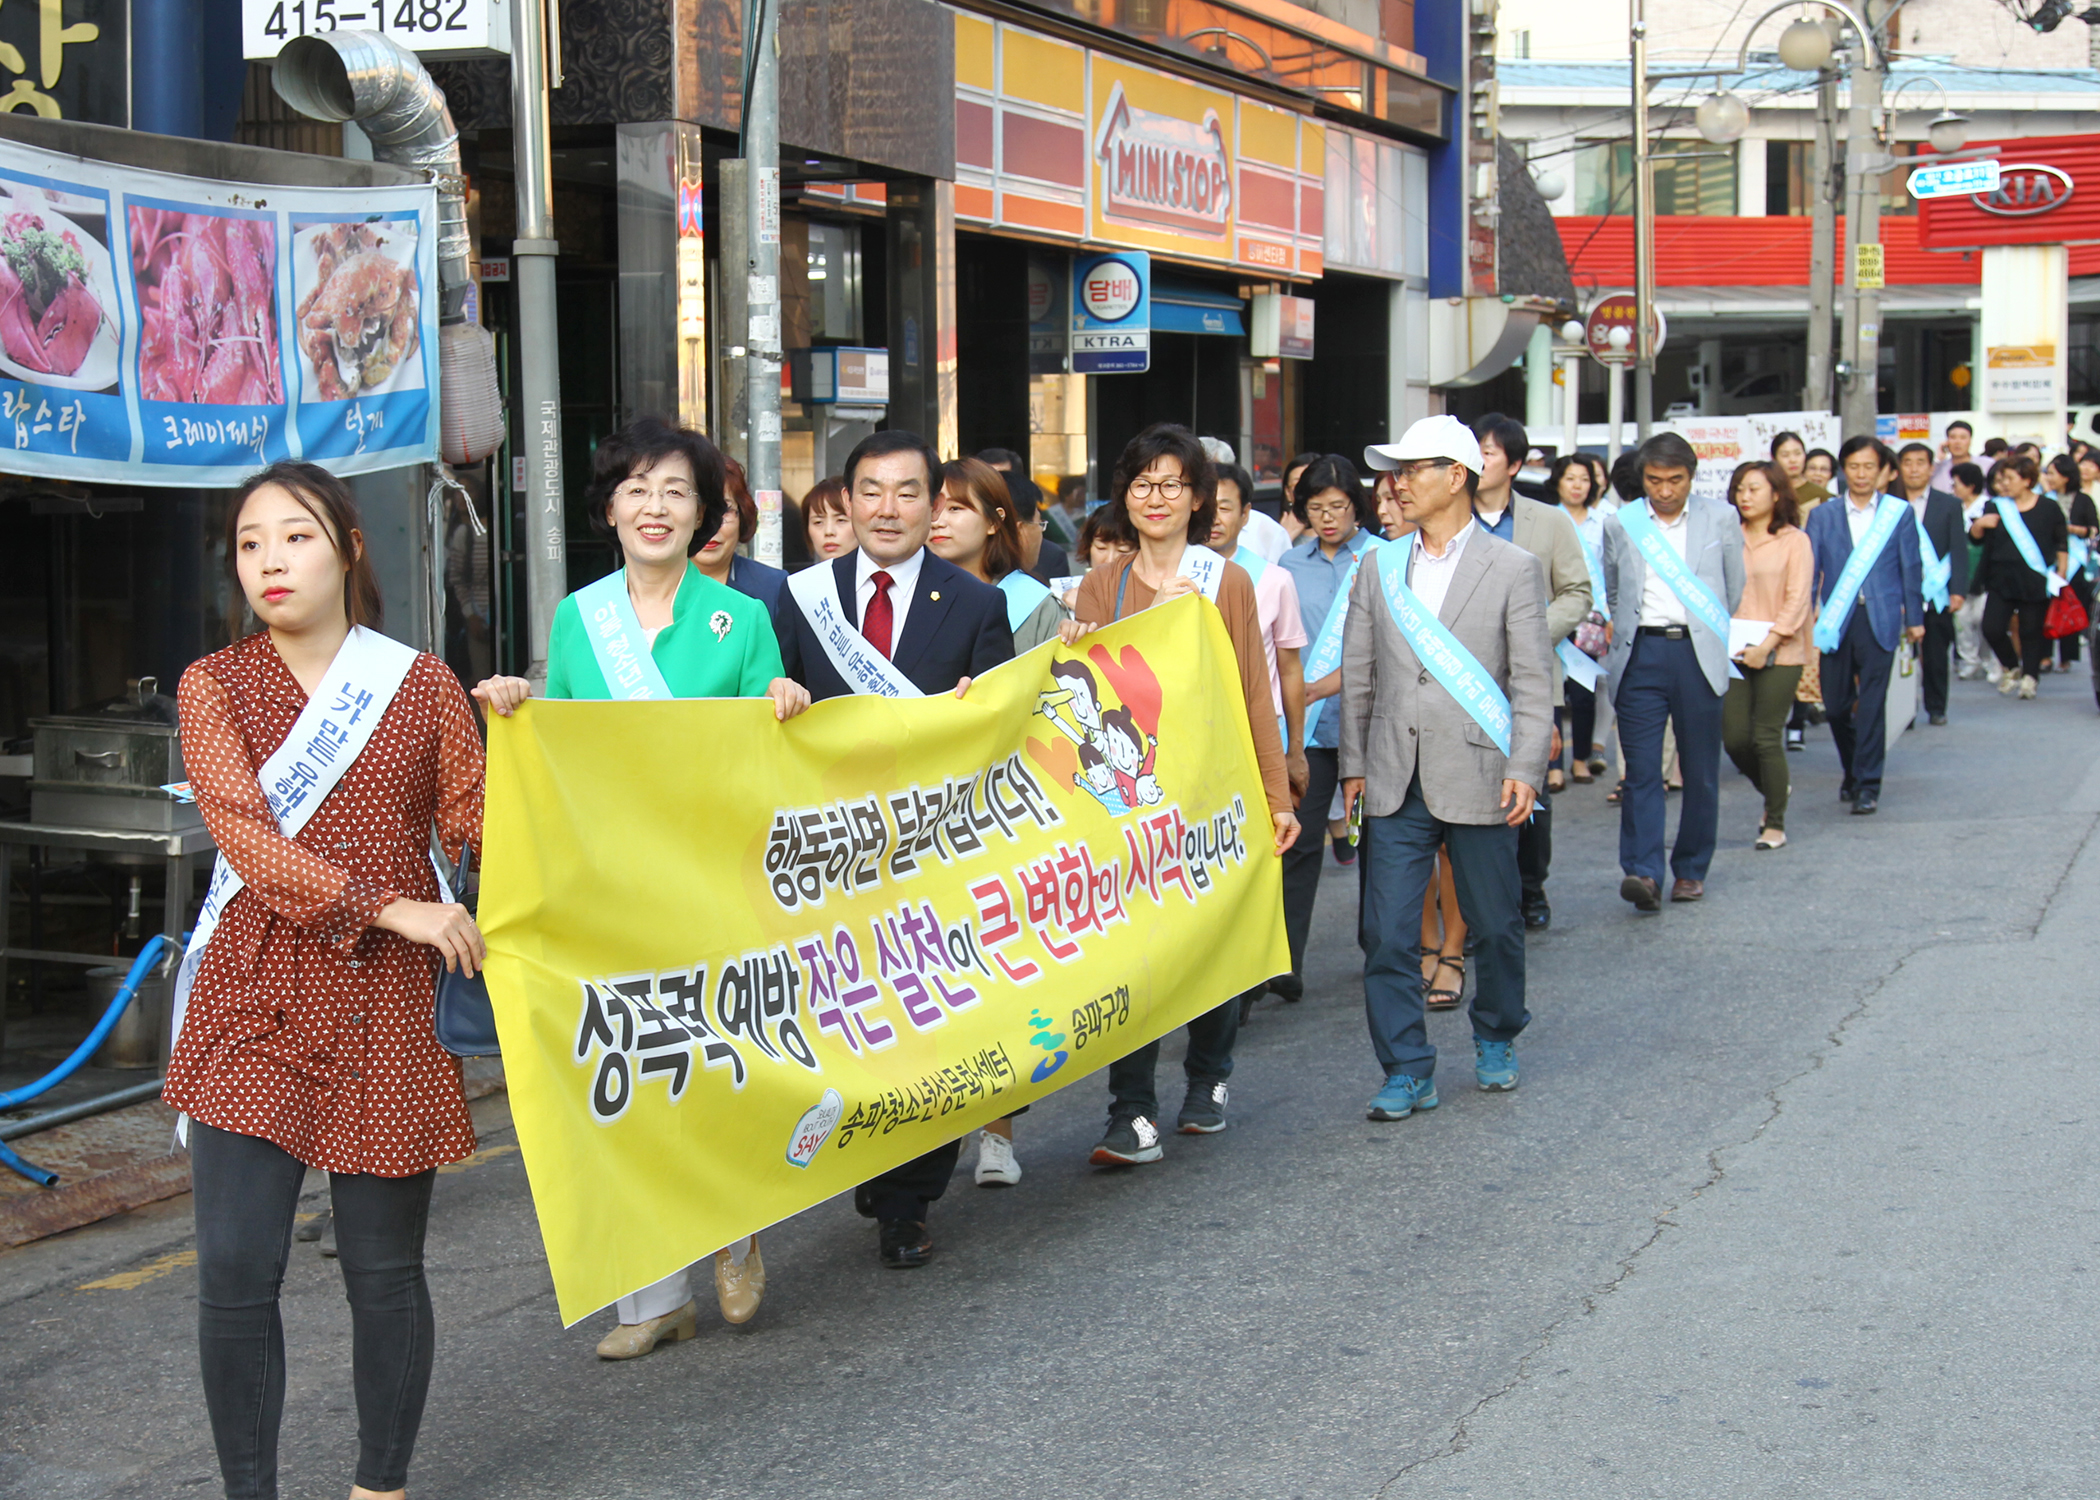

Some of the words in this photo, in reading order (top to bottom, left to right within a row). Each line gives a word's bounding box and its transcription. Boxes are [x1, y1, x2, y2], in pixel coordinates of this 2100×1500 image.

[1112, 138, 1225, 215] MINISTOP
[1988, 174, 2056, 204] KIA
[1089, 279, 1132, 302] 담배
[1084, 336, 1134, 348] KTRA
[345, 401, 384, 455] 털게
[540, 400, 560, 517] 국제관광도시
[546, 525, 562, 564] 송파
[1190, 560, 1213, 584] 내가
[594, 600, 623, 639] 아동
[813, 596, 834, 631] 내가
[829, 623, 852, 658] 만든
[605, 633, 644, 689] 청소년
[1320, 635, 1341, 661] 우리
[1393, 591, 1422, 633] 청소년
[1415, 627, 1464, 677] 유해환경
[1456, 671, 1486, 701] 우리
[1478, 694, 1511, 734] 모두의
[329, 681, 374, 726] 내가
[305, 718, 349, 768] 만든
[765, 798, 888, 908] 행동하면
[889, 753, 1060, 876] 달라집니다!
[577, 968, 745, 1117] 성폭력
[716, 949, 817, 1069] 예방
[797, 929, 894, 1052] 작은
[872, 904, 991, 1027] 실천이
[970, 878, 1039, 981] 큰
[1017, 844, 1126, 960] 변화의
[1071, 983, 1130, 1051] 송파구청
[837, 1040, 1017, 1149] 송파청소년성문화센터
[793, 1130, 828, 1158] SAY
